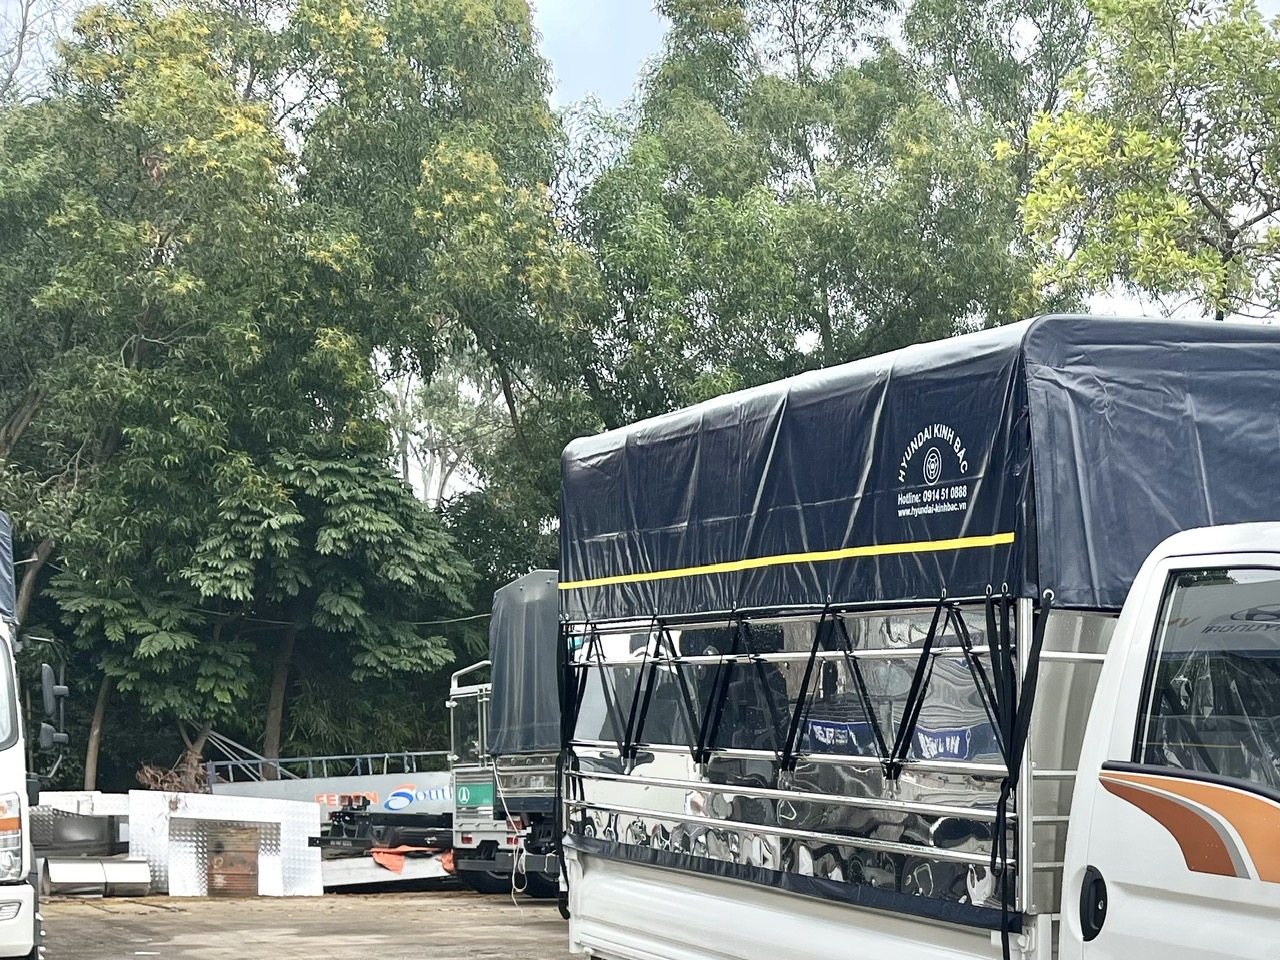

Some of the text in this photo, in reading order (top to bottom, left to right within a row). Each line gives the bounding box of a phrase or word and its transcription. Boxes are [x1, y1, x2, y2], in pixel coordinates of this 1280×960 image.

[898, 425, 933, 483] HYUNDAI
[933, 423, 955, 445] KINH
[898, 485, 968, 505] Hotline: 0914 51 0888
[897, 501, 967, 518] www.hyundai-kinhbac.vn
[314, 792, 379, 807] FEN
